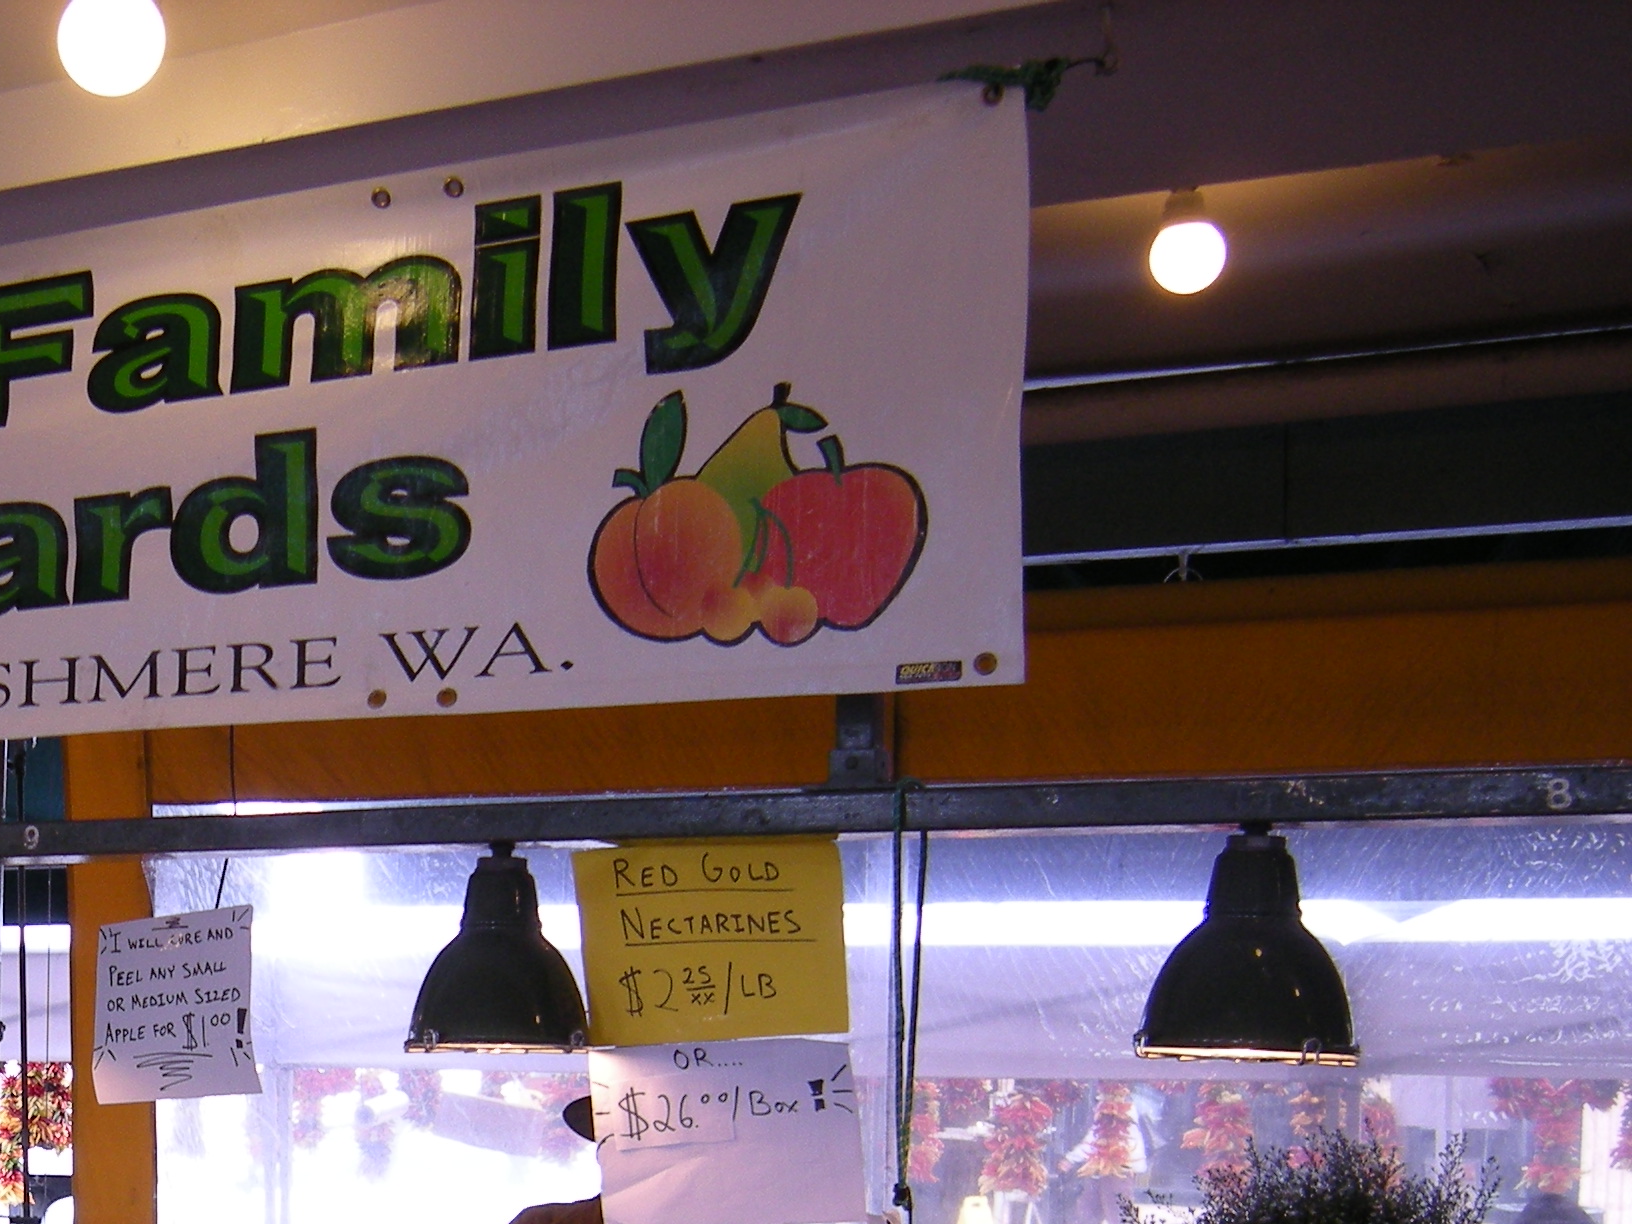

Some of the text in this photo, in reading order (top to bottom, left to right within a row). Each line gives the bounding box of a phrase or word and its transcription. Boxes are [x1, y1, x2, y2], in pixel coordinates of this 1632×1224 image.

[378, 622, 574, 683] WA.
[1547, 778, 1572, 809] 8
[613, 852, 780, 889] RED GOLD
[128, 936, 162, 949] WILL
[207, 927, 234, 941] AND
[620, 907, 802, 941] NECTARINES
[109, 961, 227, 987] PEEL ANY SMALL
[107, 987, 241, 1012] OR MEDIUM SIZED
[105, 1023, 146, 1047] APPLE
[153, 1022, 177, 1038] FOR
